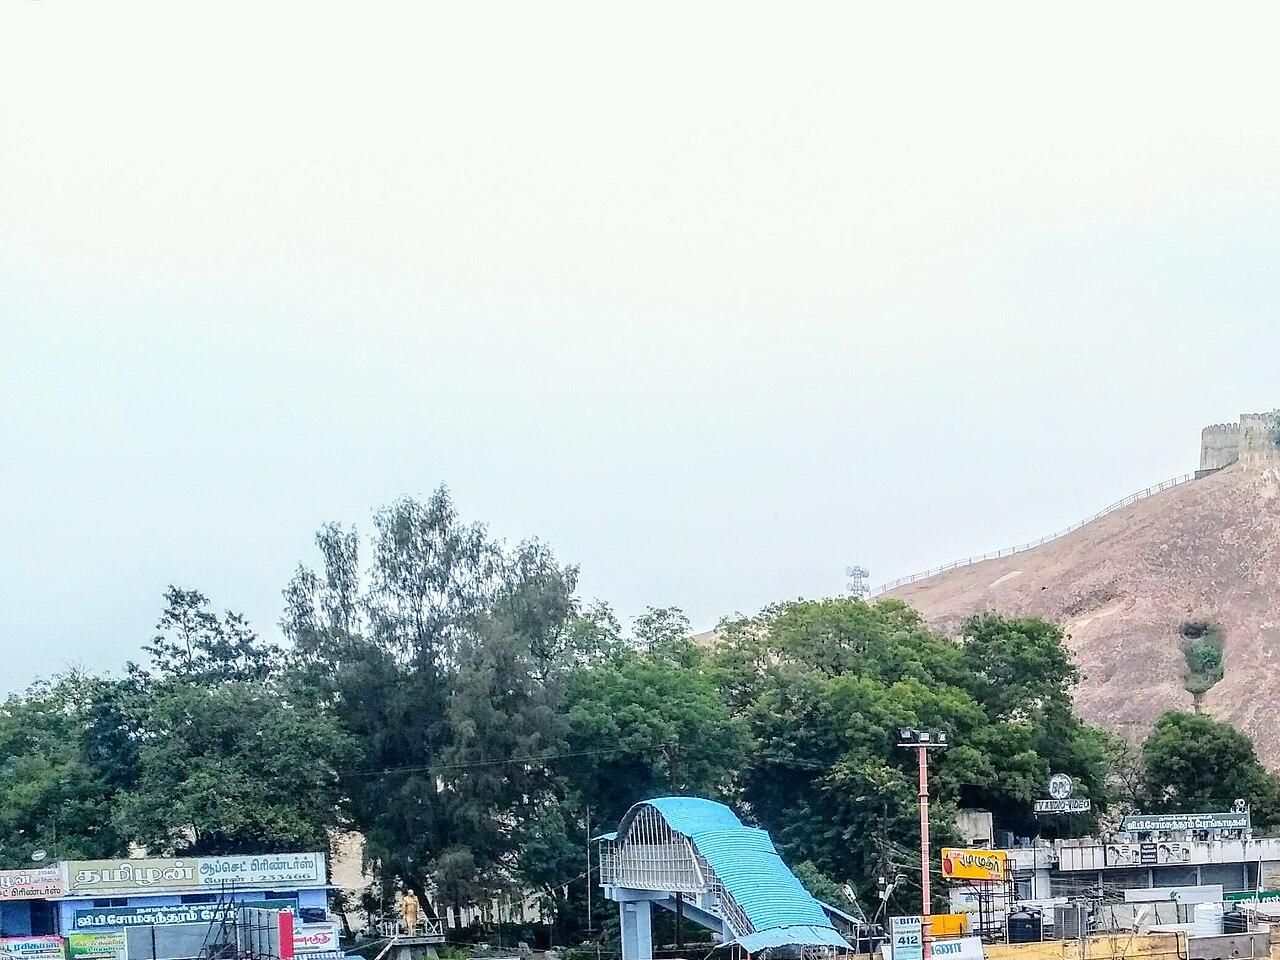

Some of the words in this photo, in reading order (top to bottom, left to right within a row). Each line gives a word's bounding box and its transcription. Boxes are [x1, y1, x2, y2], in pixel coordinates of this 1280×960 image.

[200, 859, 247, 876] ஆப்செட்
[251, 857, 315, 872] பிரிண்டர்ஸ்
[73, 860, 195, 888] தமிழன்
[204, 875, 245, 884] போன்
[258, 873, 311, 881] 233466
[11, 886, 61, 897] பிரிண்டர்ஸ்
[897, 935, 919, 945] 412
